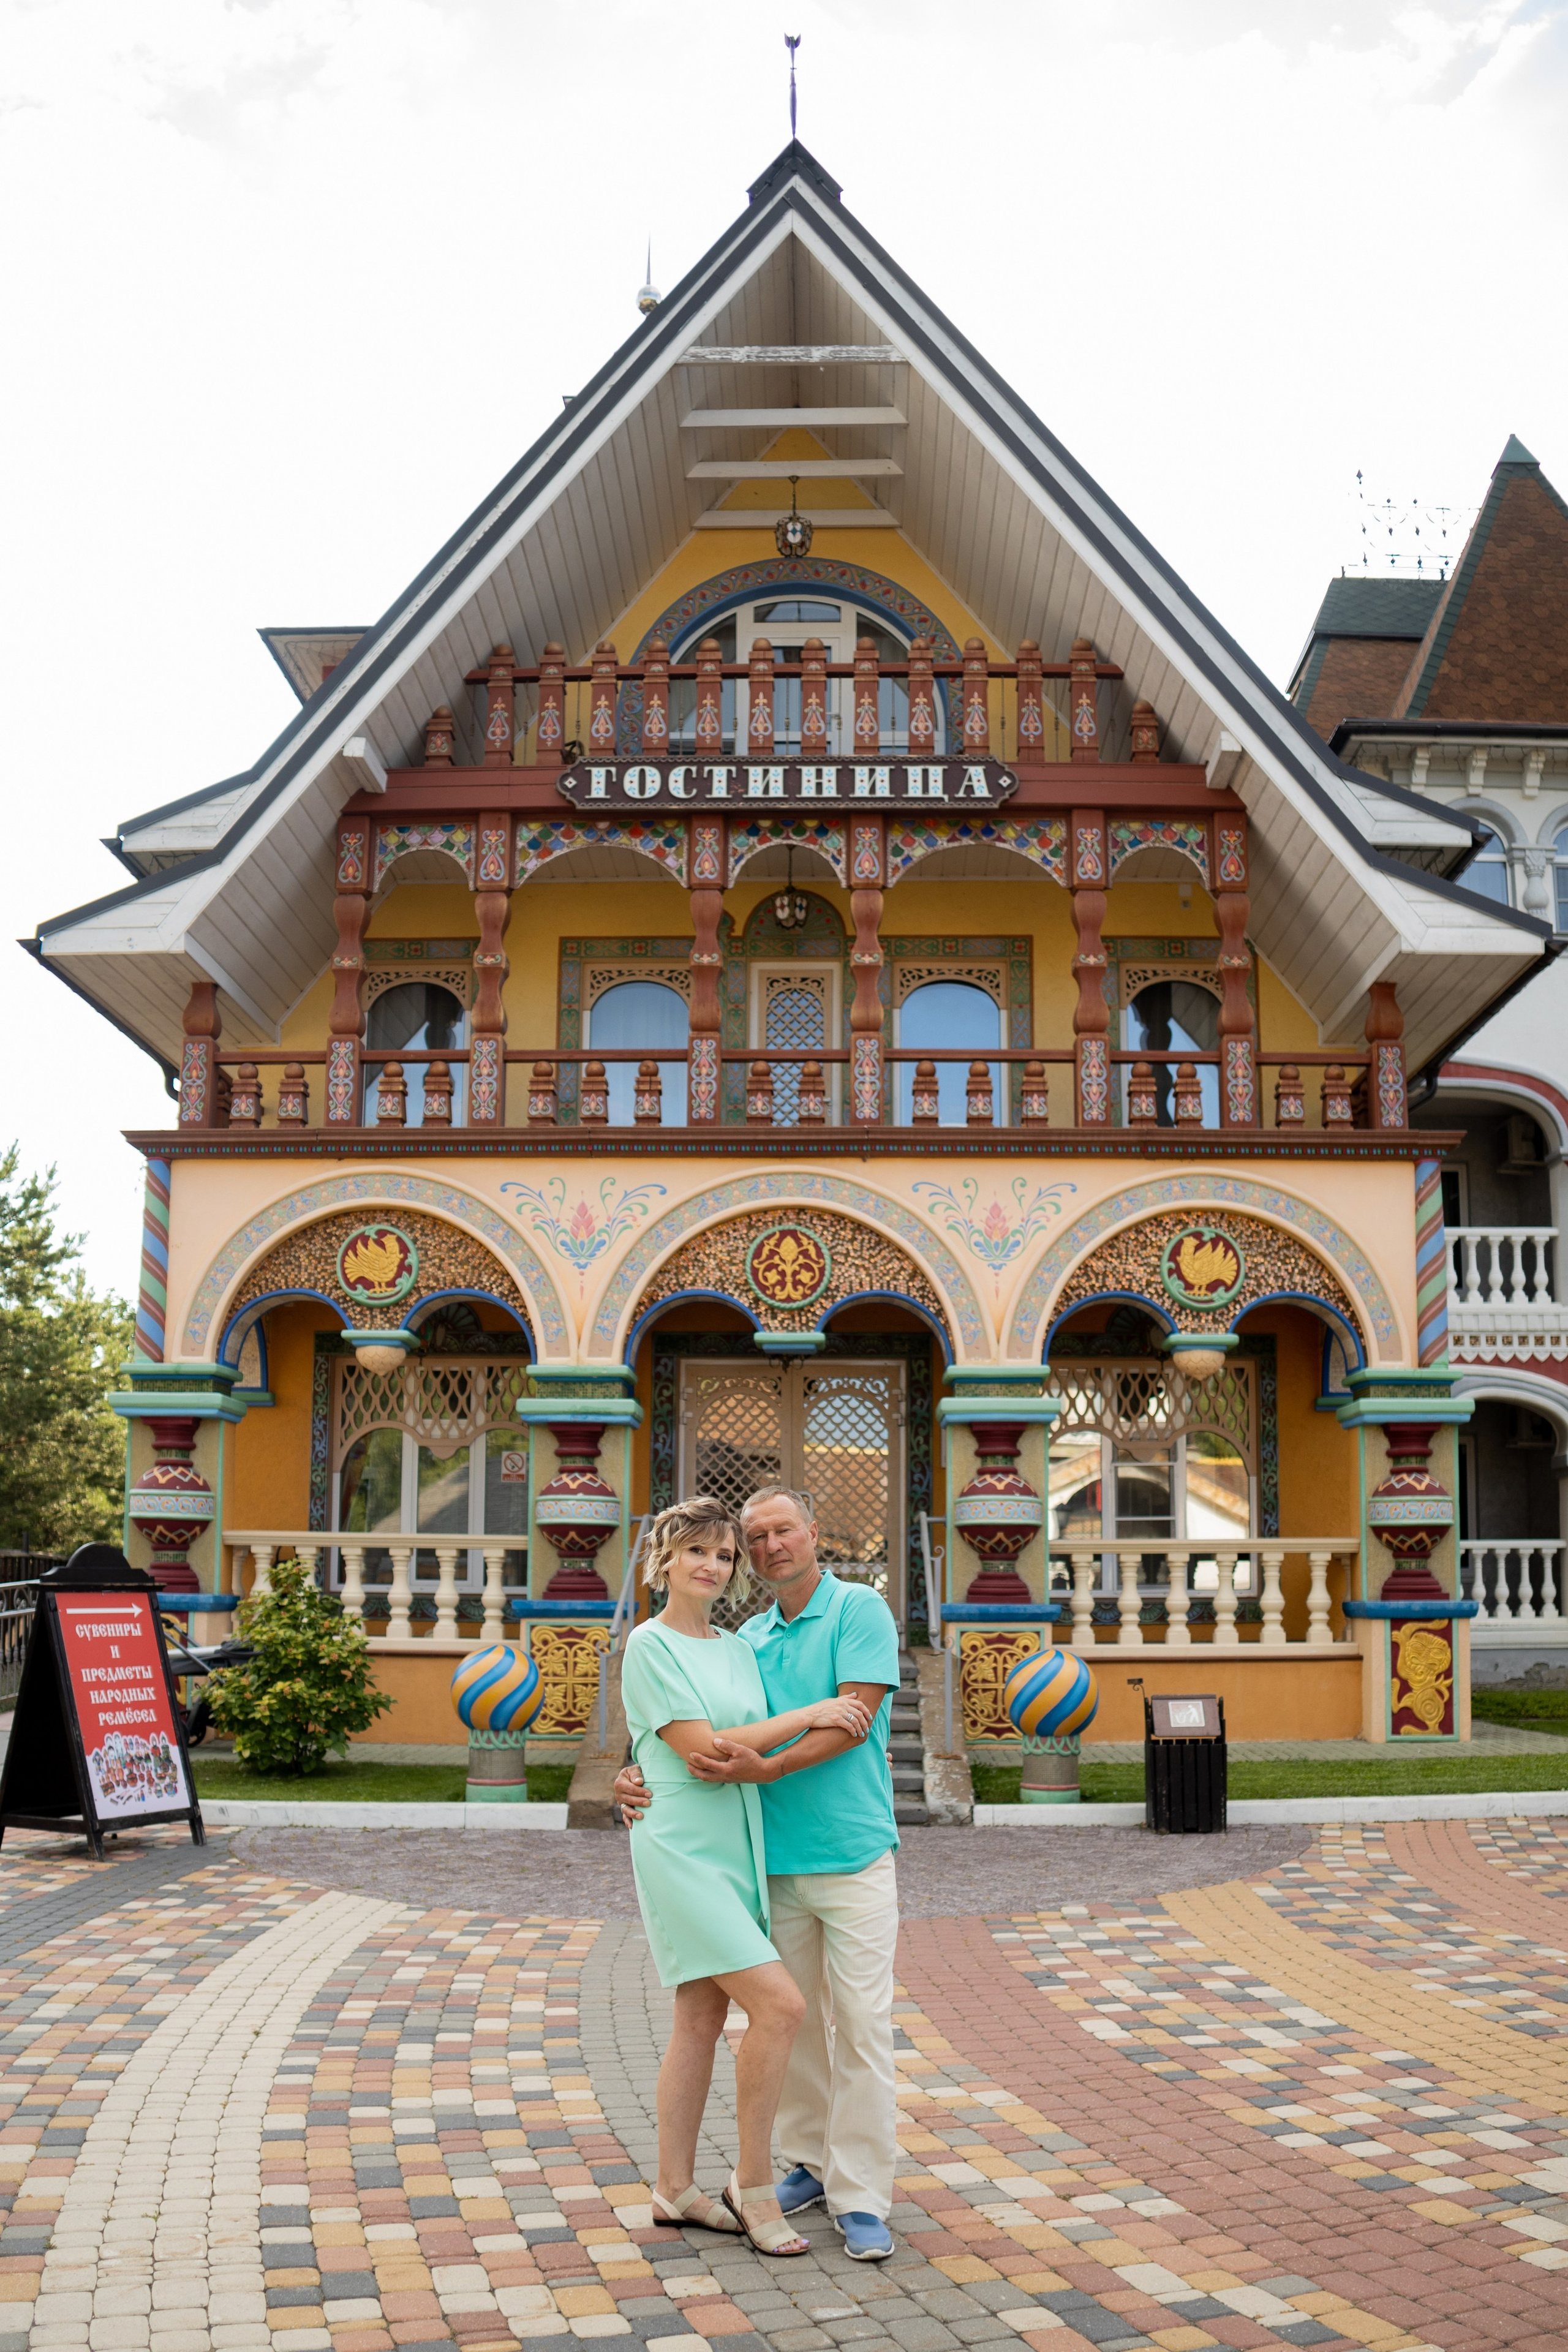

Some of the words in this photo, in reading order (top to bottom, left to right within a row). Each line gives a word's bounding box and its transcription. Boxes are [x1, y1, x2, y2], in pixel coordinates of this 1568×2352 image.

[584, 765, 992, 802] ГОСТИНИЦА
[75, 1623, 142, 1641] СУВЕНИРЫ
[110, 1645, 120, 1659] И
[81, 1665, 153, 1683] ПРЕДМЕТЫ
[89, 1687, 156, 1705] НАРОДНЫХ
[98, 1707, 157, 1726] РЕМЁСЕЛ
